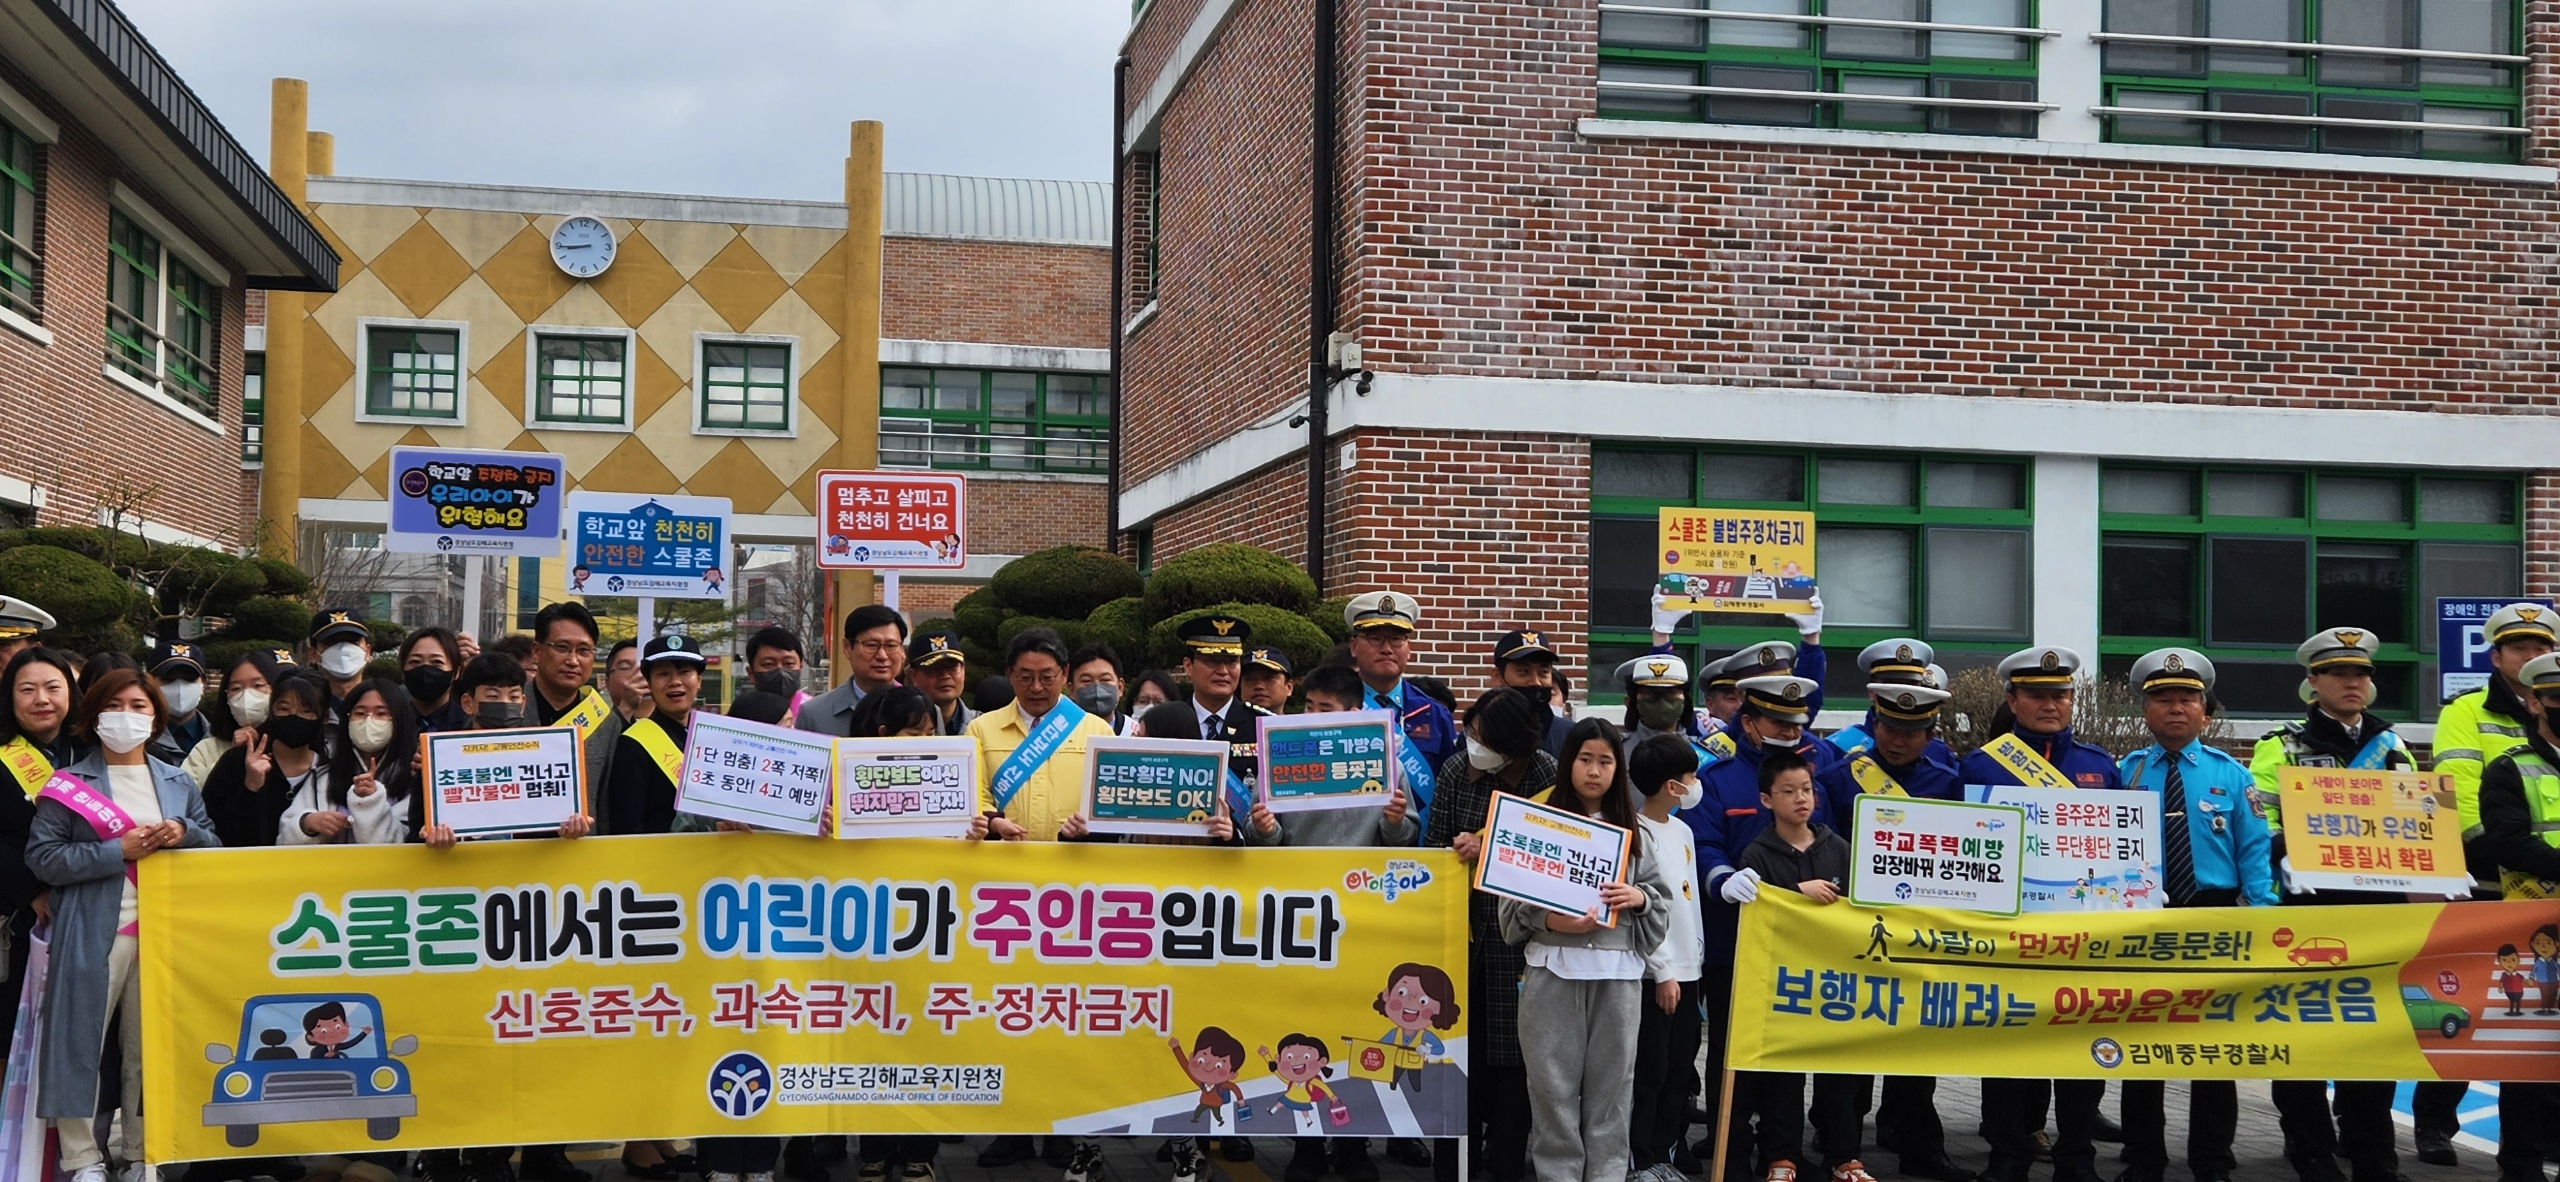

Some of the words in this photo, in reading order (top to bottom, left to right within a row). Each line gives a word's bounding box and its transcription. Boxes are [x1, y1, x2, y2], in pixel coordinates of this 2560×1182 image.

[605, 243, 611, 251] 3
[581, 265, 587, 273] 6
[428, 465, 472, 481] 학교앞
[477, 467, 519, 482] 주정차
[524, 469, 552, 484] 금지
[431, 484, 535, 504] 우리아이가
[837, 487, 890, 506] 멈추고
[896, 488, 948, 508] 살피고
[440, 505, 524, 527] 위험해요
[837, 510, 890, 530] 천천히
[896, 512, 948, 531] 건너요
[585, 516, 646, 541] 학교앞
[654, 520, 714, 544] 천천히
[1668, 517, 1708, 543] 스쿨존
[1713, 518, 1804, 546] 불법주정차금지
[584, 543, 646, 567] 안전한
[652, 546, 713, 569] 스쿨존
[2444, 604, 2476, 616] 장애인
[1018, 713, 1069, 768] 횡단보도
[1271, 740, 1334, 758] 핸드폰은
[1338, 737, 1384, 754] 가방속
[438, 766, 513, 786] 초록불엔
[518, 763, 570, 782] 건너고
[695, 746, 718, 764] 1단
[724, 750, 757, 770] 멈춤!
[761, 758, 786, 776] 2쪽
[790, 764, 824, 784] 저쪽!
[1098, 764, 1176, 786] 무단횡단
[1178, 768, 1214, 786] NO!
[1272, 762, 1326, 784] 안전한
[1997, 740, 2063, 788] 방향지시
[691, 770, 715, 786] 3초
[720, 774, 755, 794] 동안!
[759, 782, 783, 800] 4고
[788, 787, 818, 806] 예방
[854, 764, 959, 790] 횡단보도에선
[994, 765, 1024, 798] 신호
[2312, 776, 2346, 790] 사람이
[2350, 777, 2383, 791] 보이면
[444, 783, 520, 804] 빨간불엔
[526, 780, 566, 798] 멈춰!
[850, 792, 920, 815] 뛰지말고
[923, 791, 965, 814] 걷자!
[1097, 785, 1172, 806] 횡단보도
[1176, 790, 1213, 808] OK!
[2322, 792, 2345, 805] 일단
[2054, 802, 2110, 828] 음주운전
[2116, 806, 2144, 830] 금지
[2307, 813, 2377, 838] 보행자가
[2382, 816, 2434, 841] 우선인
[1496, 828, 1562, 861] 초록불엔
[1566, 848, 1612, 876] 건너고
[2056, 836, 2112, 860] 무단횡단
[2116, 838, 2144, 862] 금지
[2318, 844, 2392, 870] 교통질서
[2398, 848, 2435, 872] 확립
[1388, 861, 1416, 870] 경남교육
[1498, 846, 1566, 879] 빨간불엔
[1872, 854, 1934, 879] 입장바꿔
[1346, 870, 1430, 901] 아이좋아
[276, 886, 680, 971] 스쿨존에서는
[703, 882, 956, 956] 어린이가
[974, 886, 1340, 962] 주인공입니다
[1908, 929, 1996, 957] 사람이
[2115, 930, 2252, 962] 교통문화!
[1772, 966, 1905, 1026] 보행자
[1920, 980, 2037, 1028] 배려는
[2047, 986, 2244, 1026] 안전운전의
[2253, 976, 2378, 1023] 첫걸음
[493, 986, 693, 1038] 신호준수,
[714, 984, 906, 1036] 과속금지,
[928, 984, 1170, 1036] 주·정차금지
[1364, 1058, 1380, 1066] STOP
[2129, 1042, 2290, 1066] 김해중부경찰서
[779, 1066, 1002, 1090] 경상남도김해교육지원청
[779, 1092, 868, 1102] GYEONGSANGNAMDO
[870, 1093, 905, 1101] GIMHAE
[908, 1093, 936, 1101] OFFICE
[938, 1093, 950, 1101] OF
[951, 1093, 1000, 1102] EDUCATION
